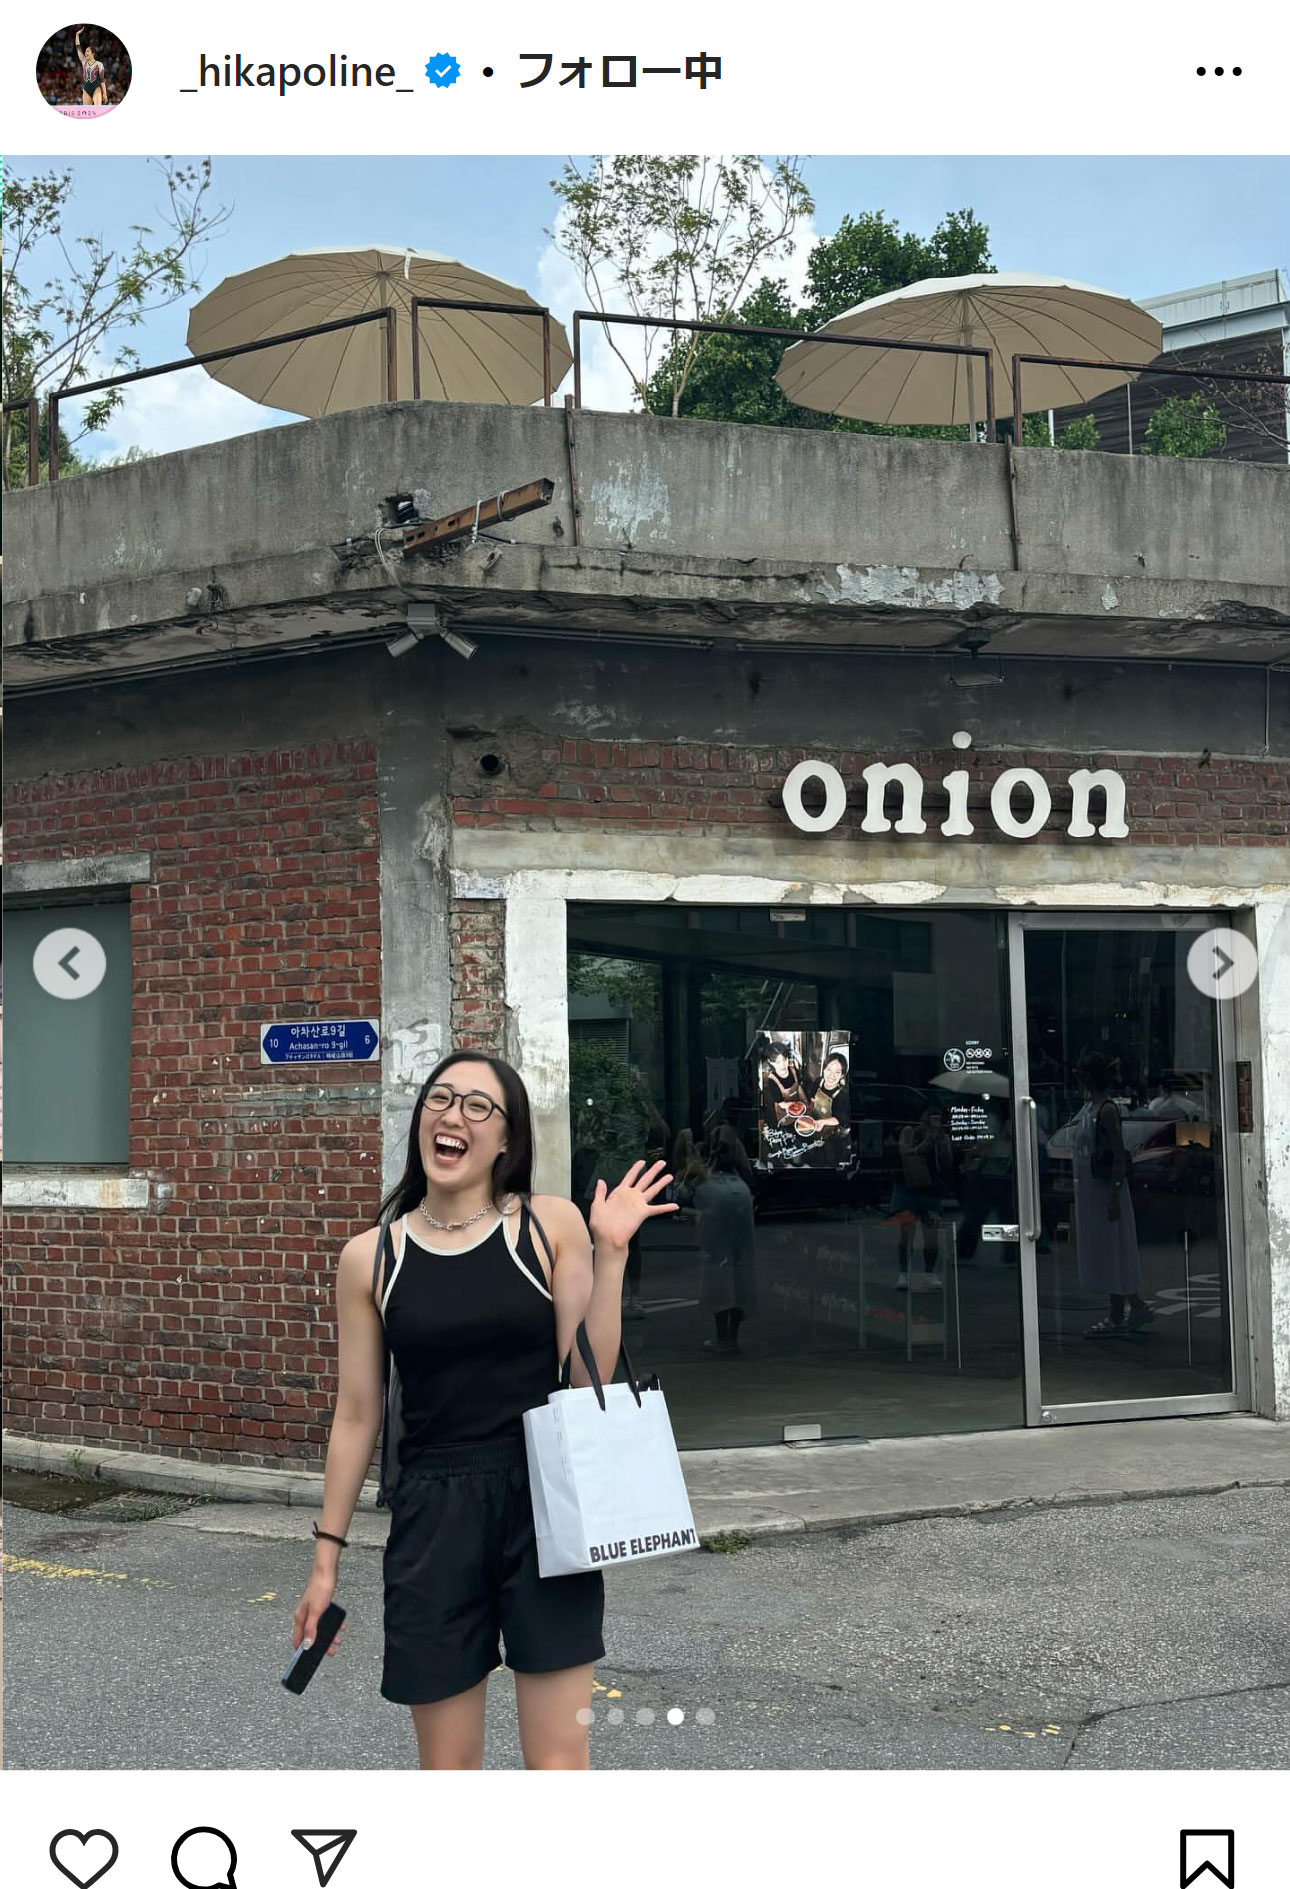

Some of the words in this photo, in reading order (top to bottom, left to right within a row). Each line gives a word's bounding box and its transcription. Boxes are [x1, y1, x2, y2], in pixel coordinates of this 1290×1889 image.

[782, 731, 1130, 839] onion
[291, 1024, 346, 1038] 아차산로9길
[269, 1038, 279, 1049] 10
[289, 1042, 329, 1050] Achasan-ro
[331, 1041, 348, 1050] 9-gil
[364, 1034, 371, 1045] 6
[589, 1541, 628, 1563] BLUE
